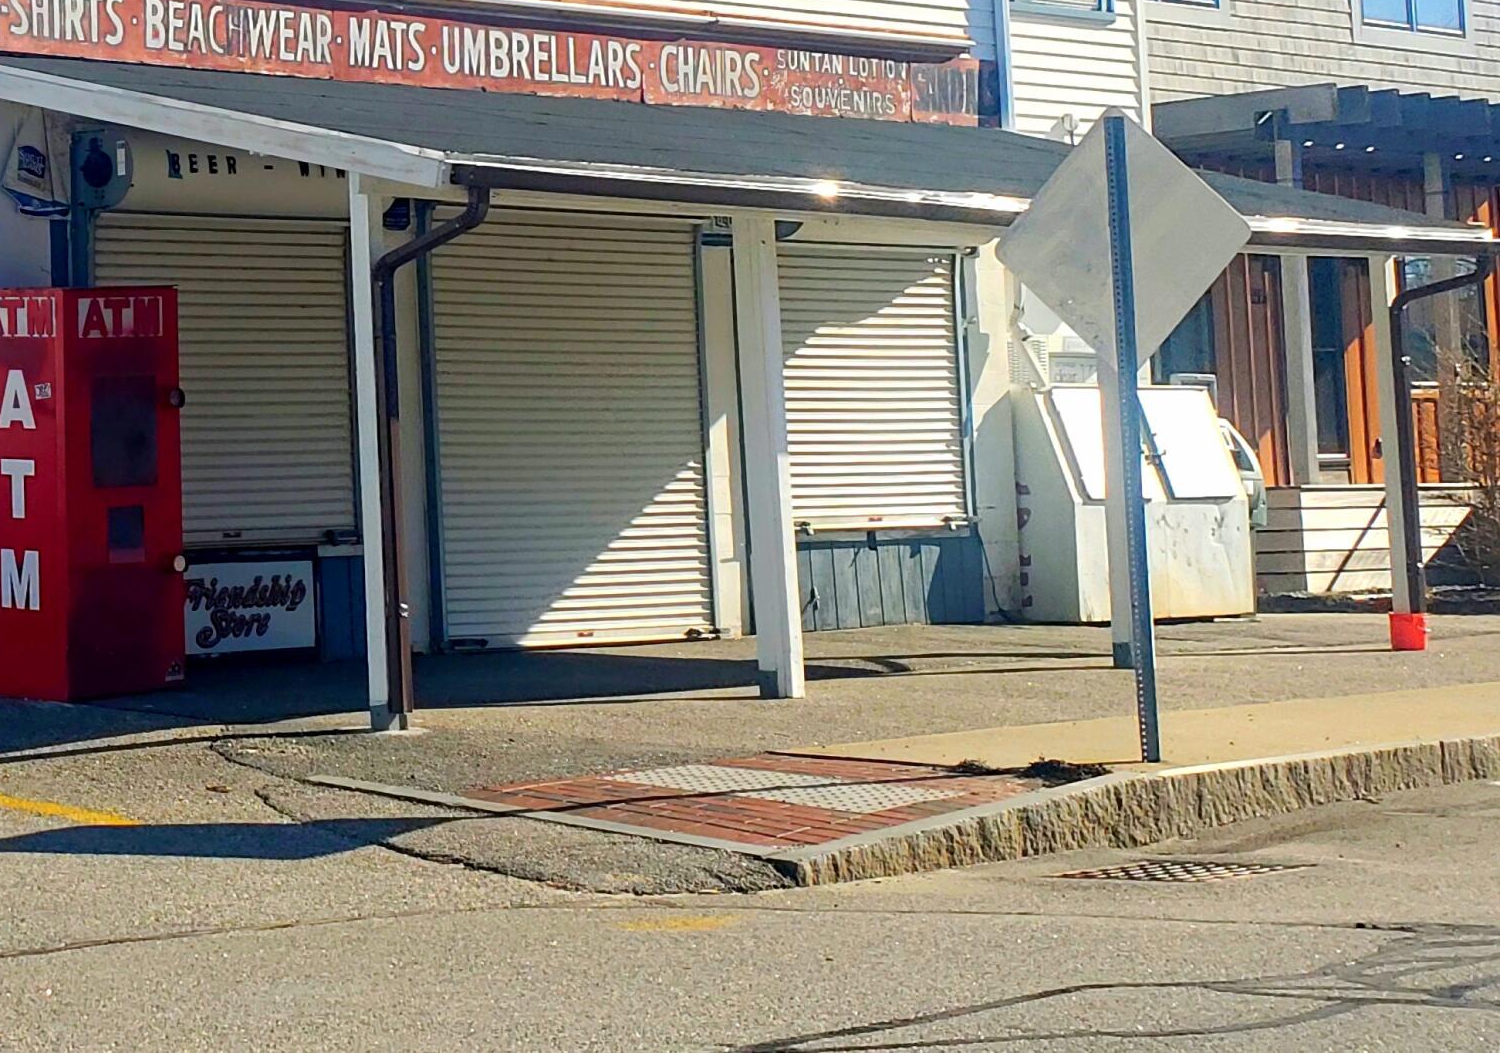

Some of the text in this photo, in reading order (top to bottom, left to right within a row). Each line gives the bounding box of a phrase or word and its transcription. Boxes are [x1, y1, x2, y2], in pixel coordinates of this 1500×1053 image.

[348, 16, 426, 72] MATS
[442, 26, 641, 89] UMBRELLARS
[659, 45, 761, 98] CHAIRS
[777, 49, 843, 75] SUNTAN
[790, 86, 897, 115] SOUVENIRS
[170, 153, 237, 175] BEER
[298, 160, 346, 179] WIN
[82, 297, 161, 338] ATM
[187, 574, 306, 611] Friendship
[196, 608, 271, 648] Store
